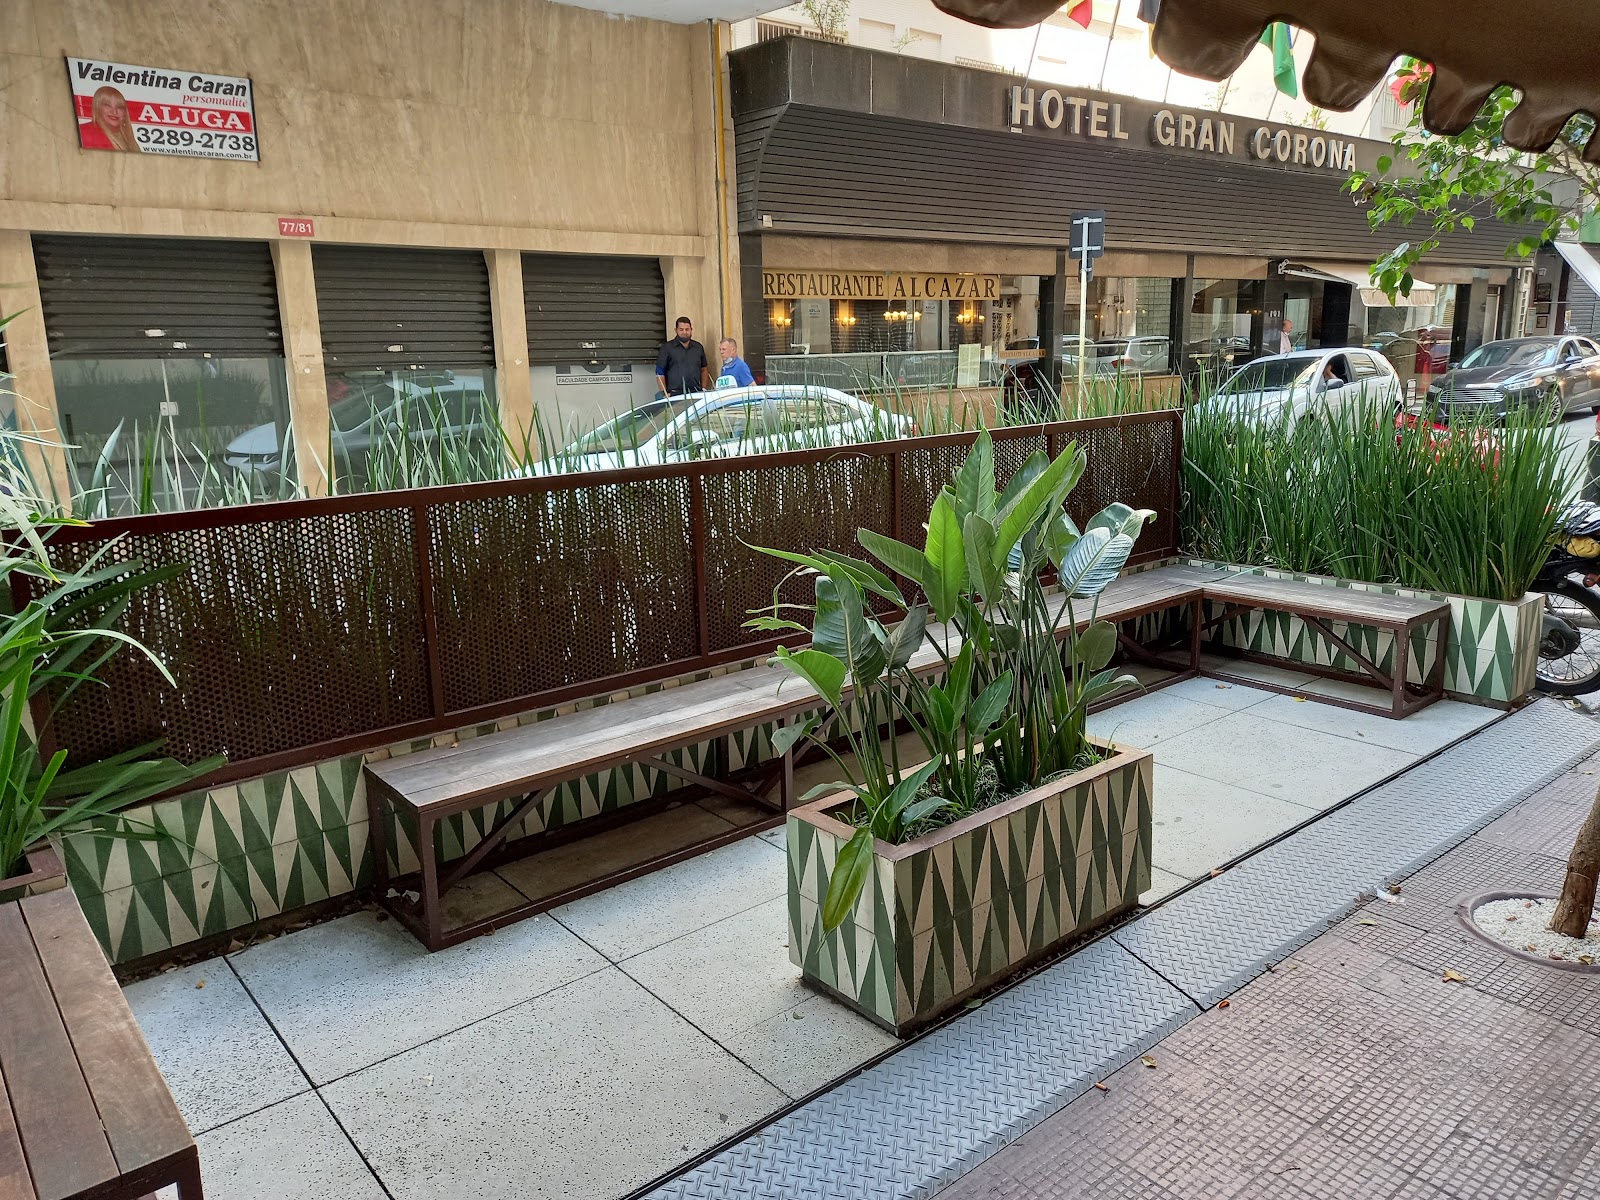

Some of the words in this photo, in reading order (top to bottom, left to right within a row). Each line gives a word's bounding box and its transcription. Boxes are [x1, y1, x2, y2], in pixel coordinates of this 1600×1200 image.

[77, 61, 182, 90] Valentina
[188, 75, 248, 97] Caran
[182, 94, 248, 108] personnalité
[138, 105, 246, 131] ALUGA
[1011, 85, 1129, 141] HOTEL
[1153, 109, 1235, 155] GRAN
[1254, 126, 1357, 172] CORONA
[136, 127, 256, 152] 3289-2738
[142, 145, 253, 160] www.valentinacaran.com.br
[281, 220, 313, 235] 77/81
[763, 272, 884, 297] RESTAURANTE
[893, 276, 996, 298] ALCAZAR
[717, 377, 730, 387] TAXI
